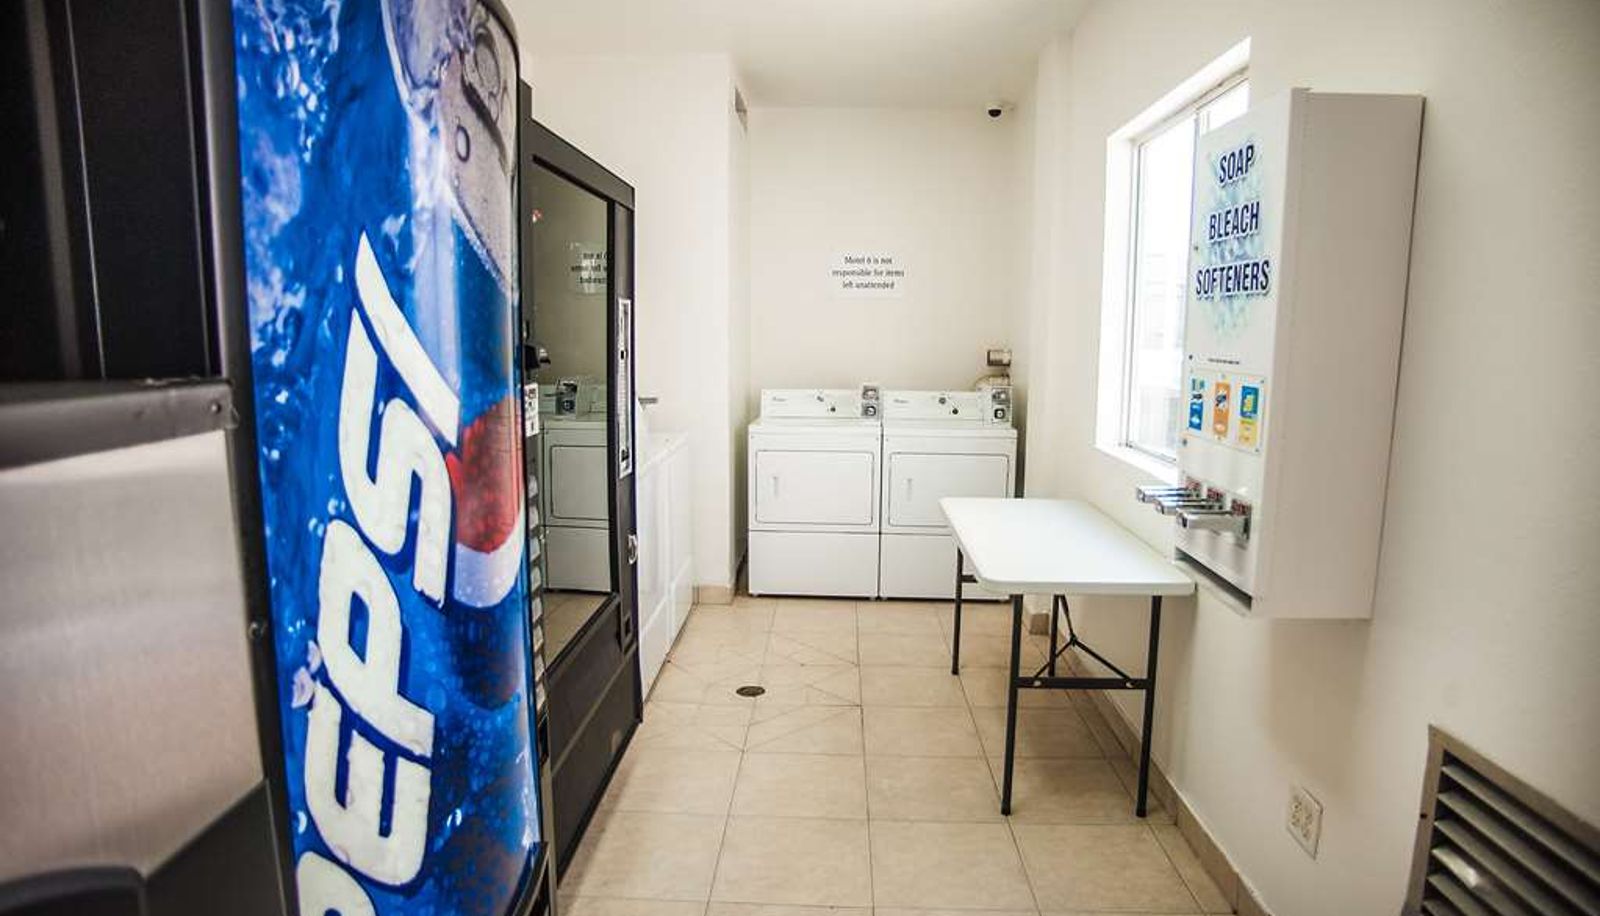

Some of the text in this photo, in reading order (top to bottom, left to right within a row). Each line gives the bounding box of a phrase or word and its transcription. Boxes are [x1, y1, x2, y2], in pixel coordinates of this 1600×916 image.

[1219, 144, 1255, 184] SOAP
[1208, 201, 1260, 241] BLEACH
[831, 268, 905, 277] responsible for items
[844, 255, 865, 264] Motel
[881, 256, 892, 264] not
[1195, 259, 1271, 297] SOFTENERS
[842, 280, 895, 289] left unattended
[295, 231, 461, 916] EPSI
